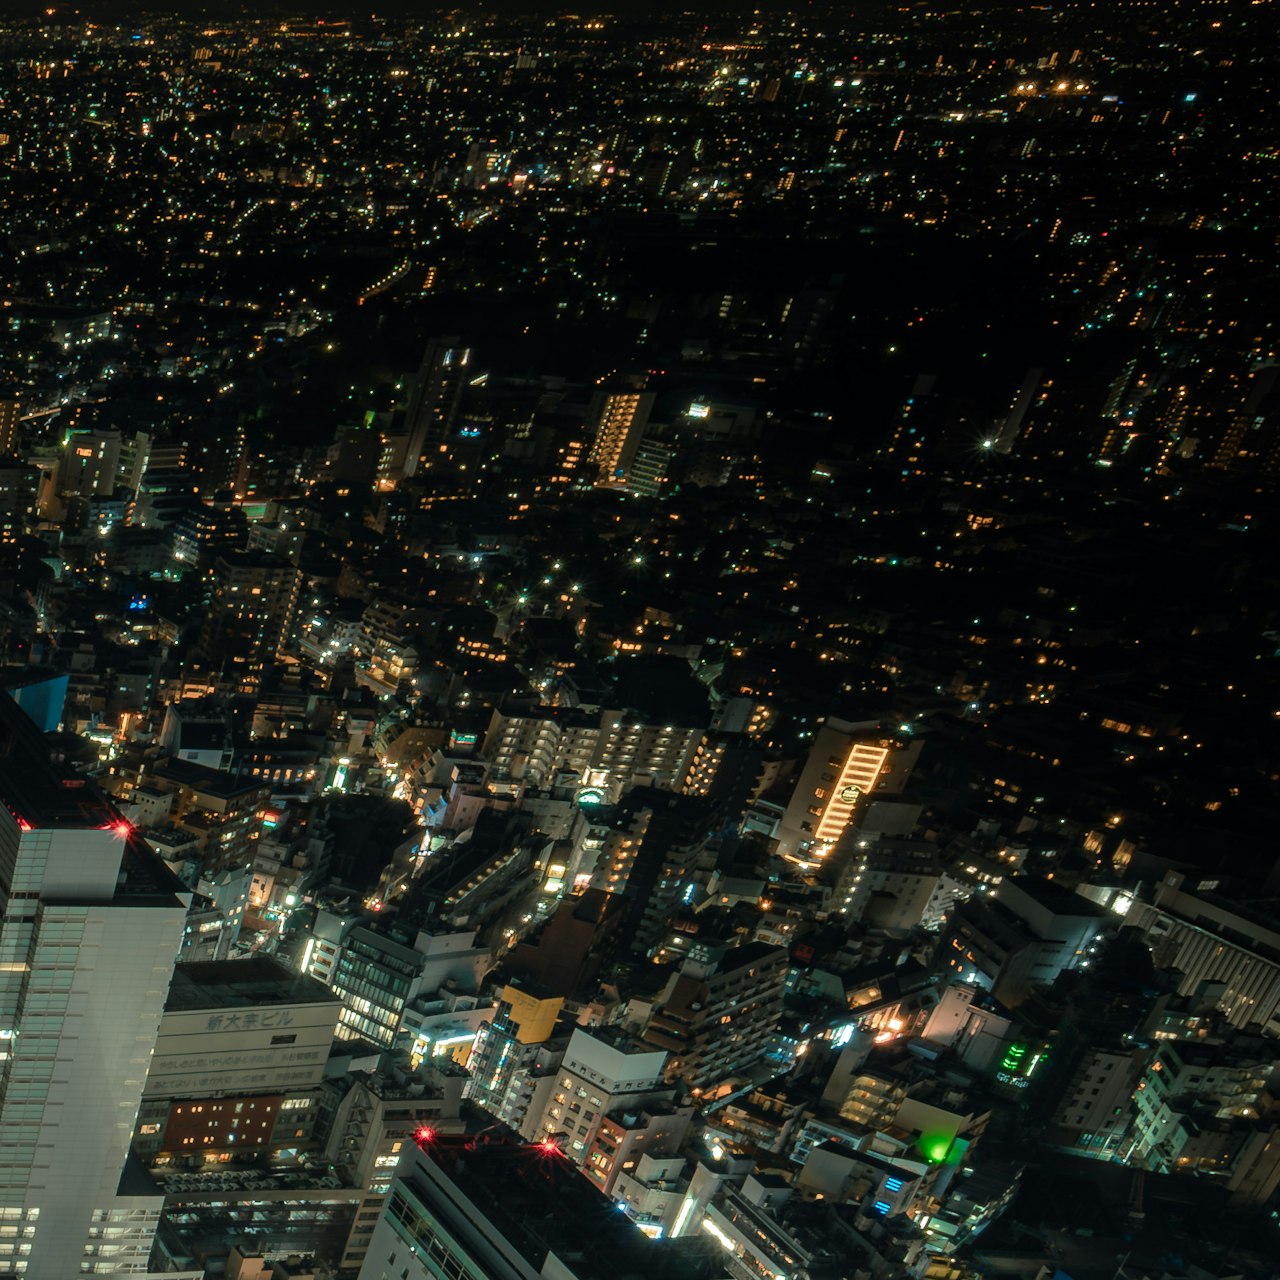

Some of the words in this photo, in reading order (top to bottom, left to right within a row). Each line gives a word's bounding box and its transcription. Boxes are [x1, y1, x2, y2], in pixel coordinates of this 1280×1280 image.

[207, 1011, 293, 1031] 新大宗ビル
